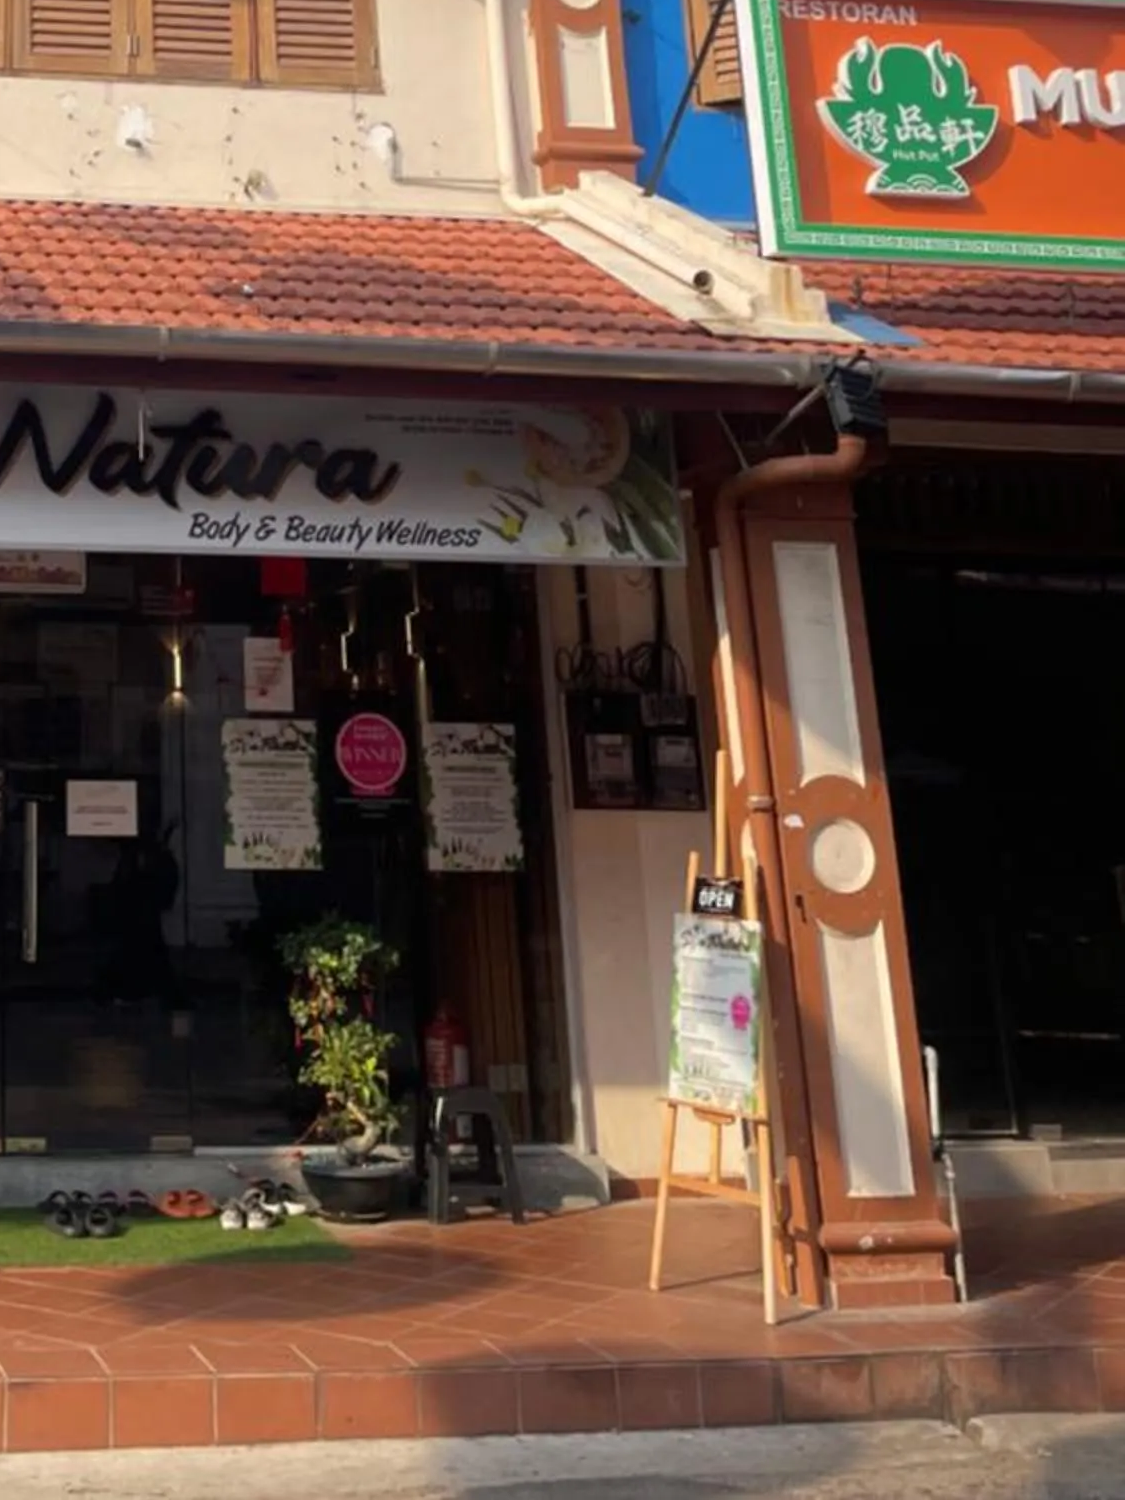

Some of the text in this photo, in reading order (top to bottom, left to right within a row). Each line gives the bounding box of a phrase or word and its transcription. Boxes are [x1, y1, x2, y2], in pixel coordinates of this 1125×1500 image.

[1008, 63, 1125, 128] MU
[187, 512, 483, 551] Body & Beauty Wellness
[698, 886, 735, 910] OPEN
